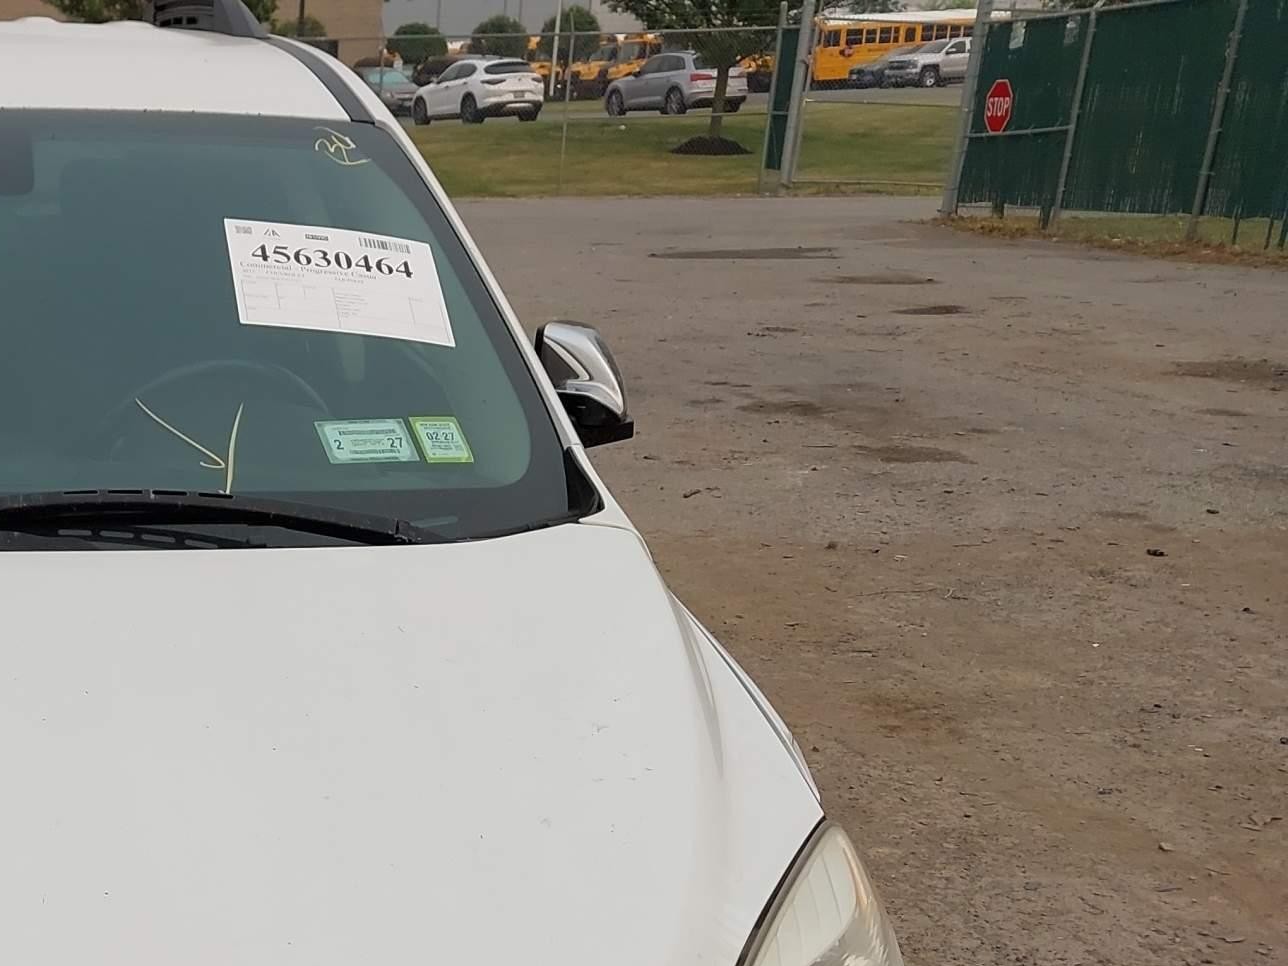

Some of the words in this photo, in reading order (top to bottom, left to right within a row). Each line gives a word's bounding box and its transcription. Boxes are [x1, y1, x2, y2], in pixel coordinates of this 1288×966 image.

[987, 97, 1010, 117] STOP
[251, 243, 413, 278] 45630464
[334, 440, 344, 450] 2
[387, 437, 403, 448] 27
